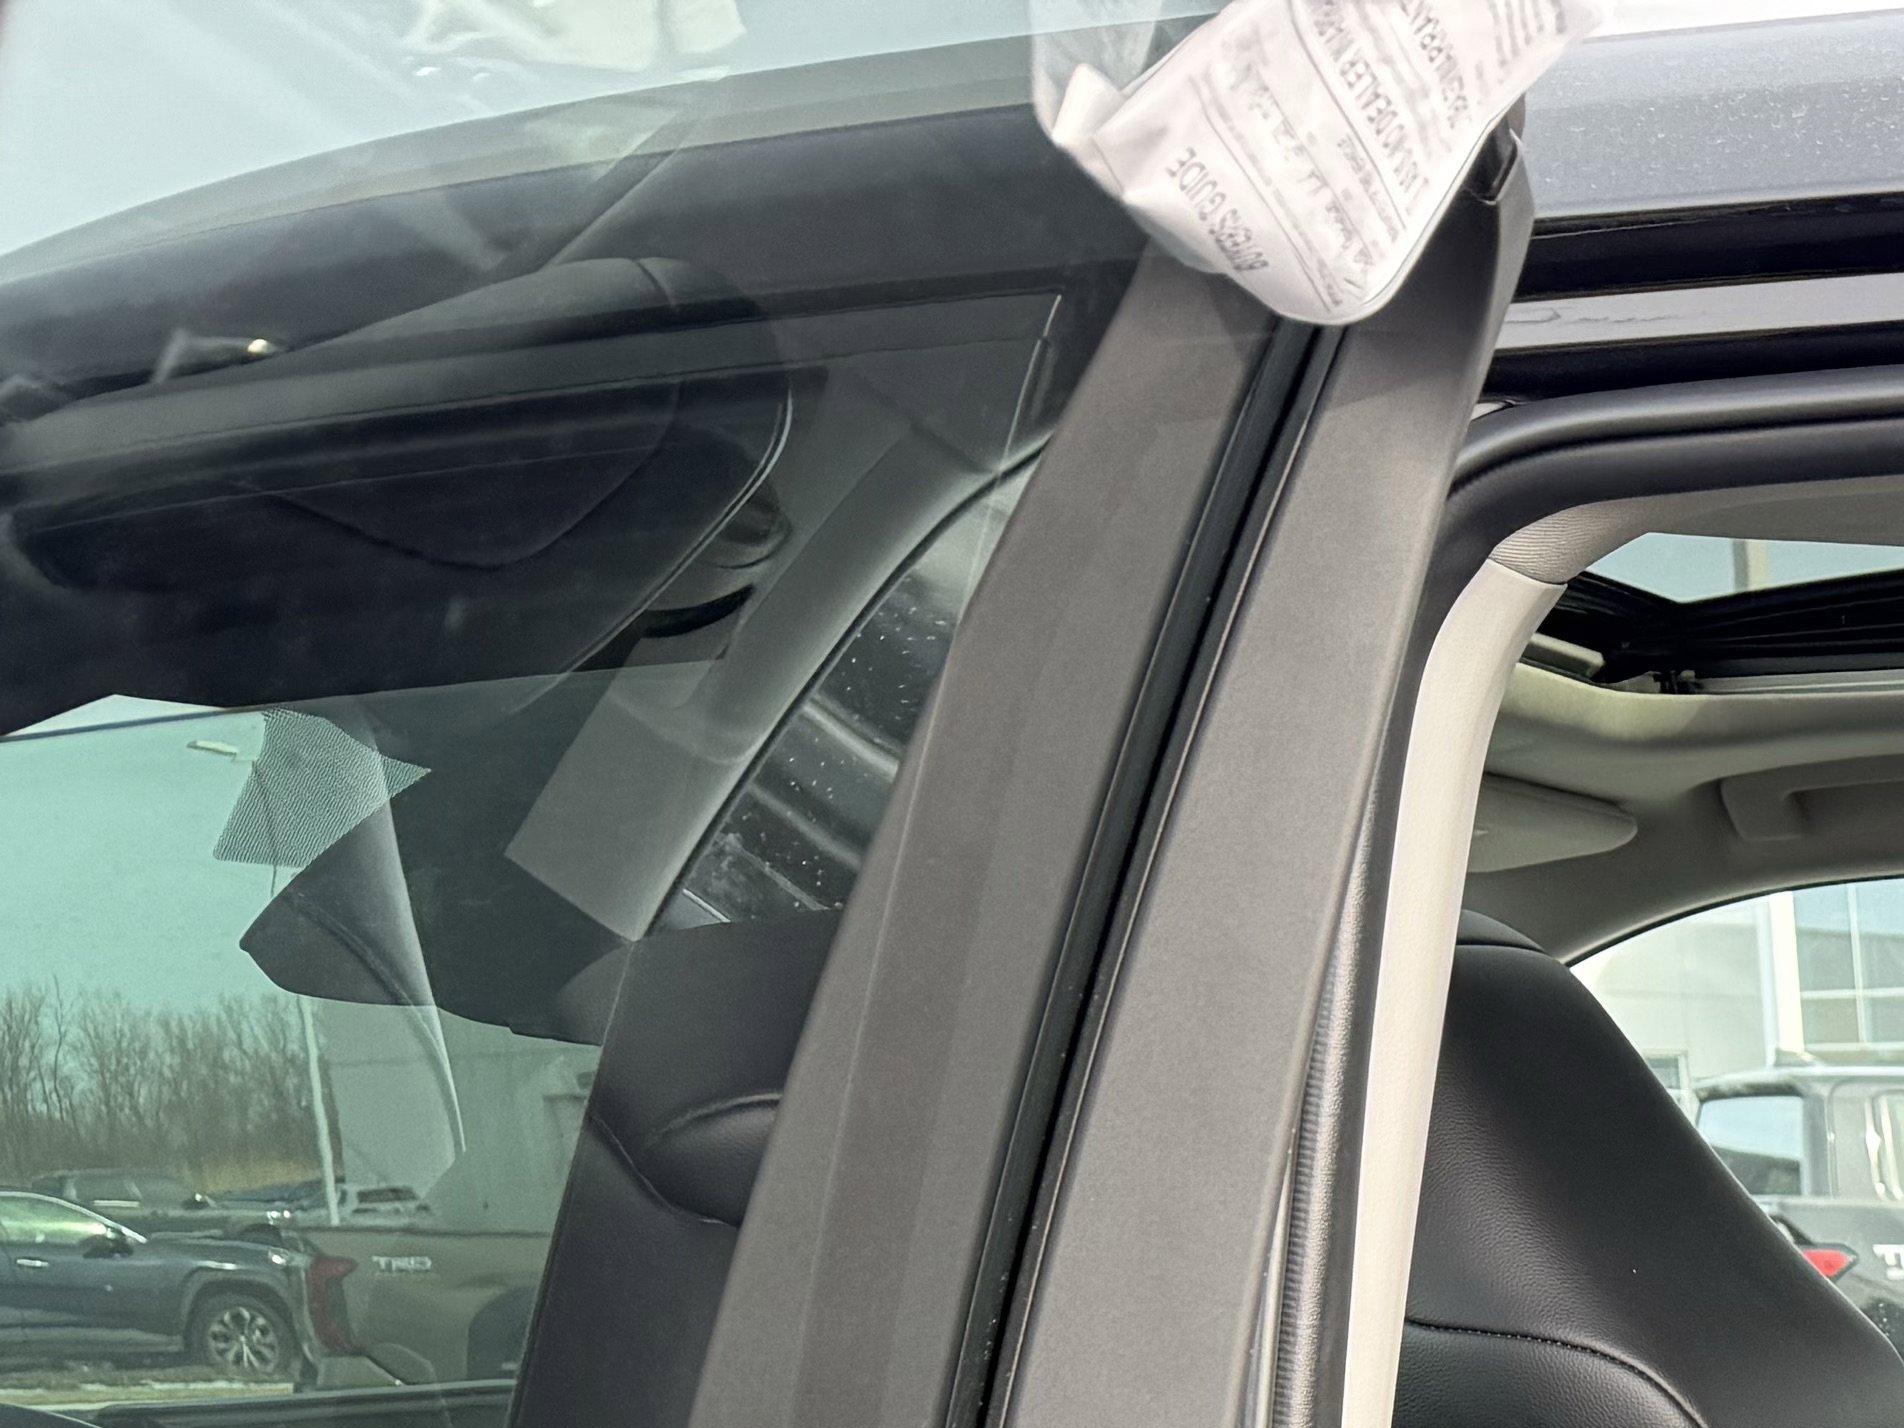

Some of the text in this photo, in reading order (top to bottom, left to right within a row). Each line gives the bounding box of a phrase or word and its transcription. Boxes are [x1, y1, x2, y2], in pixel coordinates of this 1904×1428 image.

[1339, 48, 1398, 136] DEALER
[1164, 146, 1269, 272] BUYERS GUIDE
[371, 1255, 432, 1272] TRD
